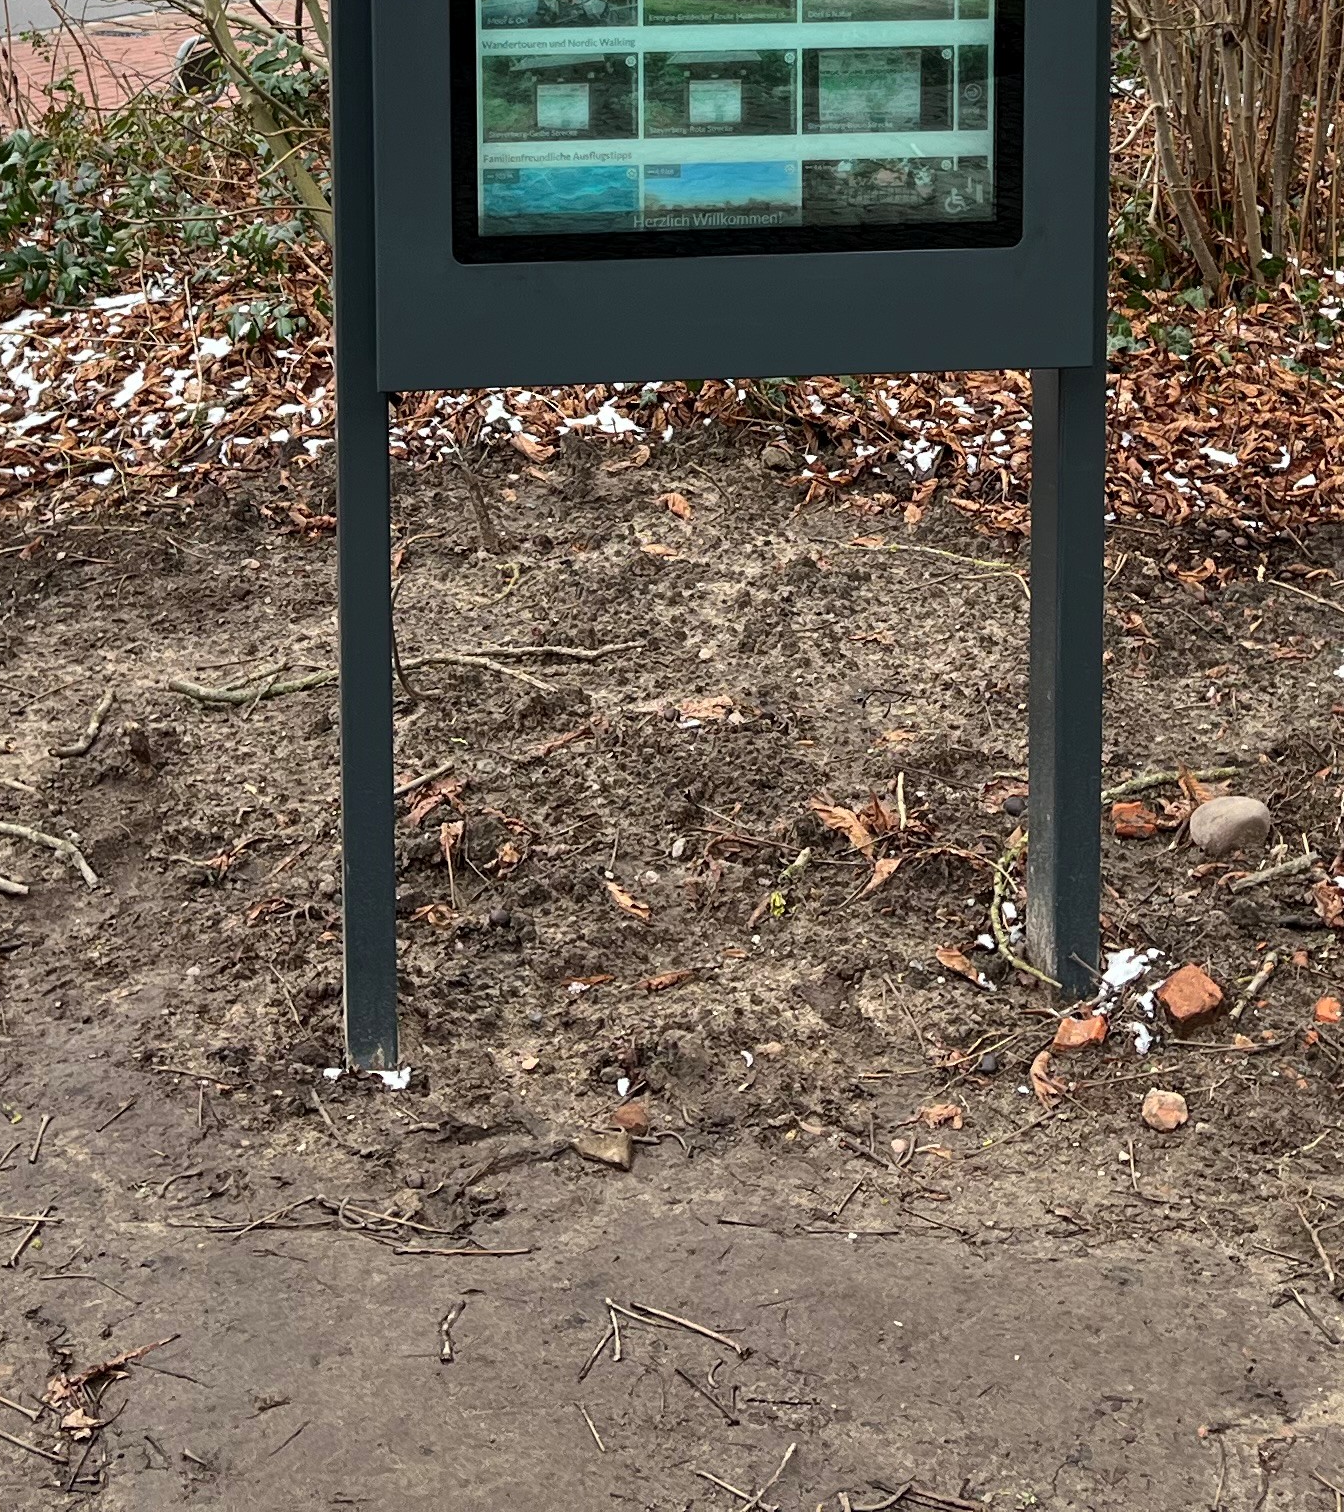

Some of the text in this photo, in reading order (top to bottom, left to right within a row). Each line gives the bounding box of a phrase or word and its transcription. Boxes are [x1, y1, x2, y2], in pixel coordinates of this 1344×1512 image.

[481, 37, 636, 50] Wandertouren und Nordic Walking
[483, 151, 633, 163] Familienfreundliche Ausflugstipps
[633, 210, 784, 229] Herzlich Willkommen!
